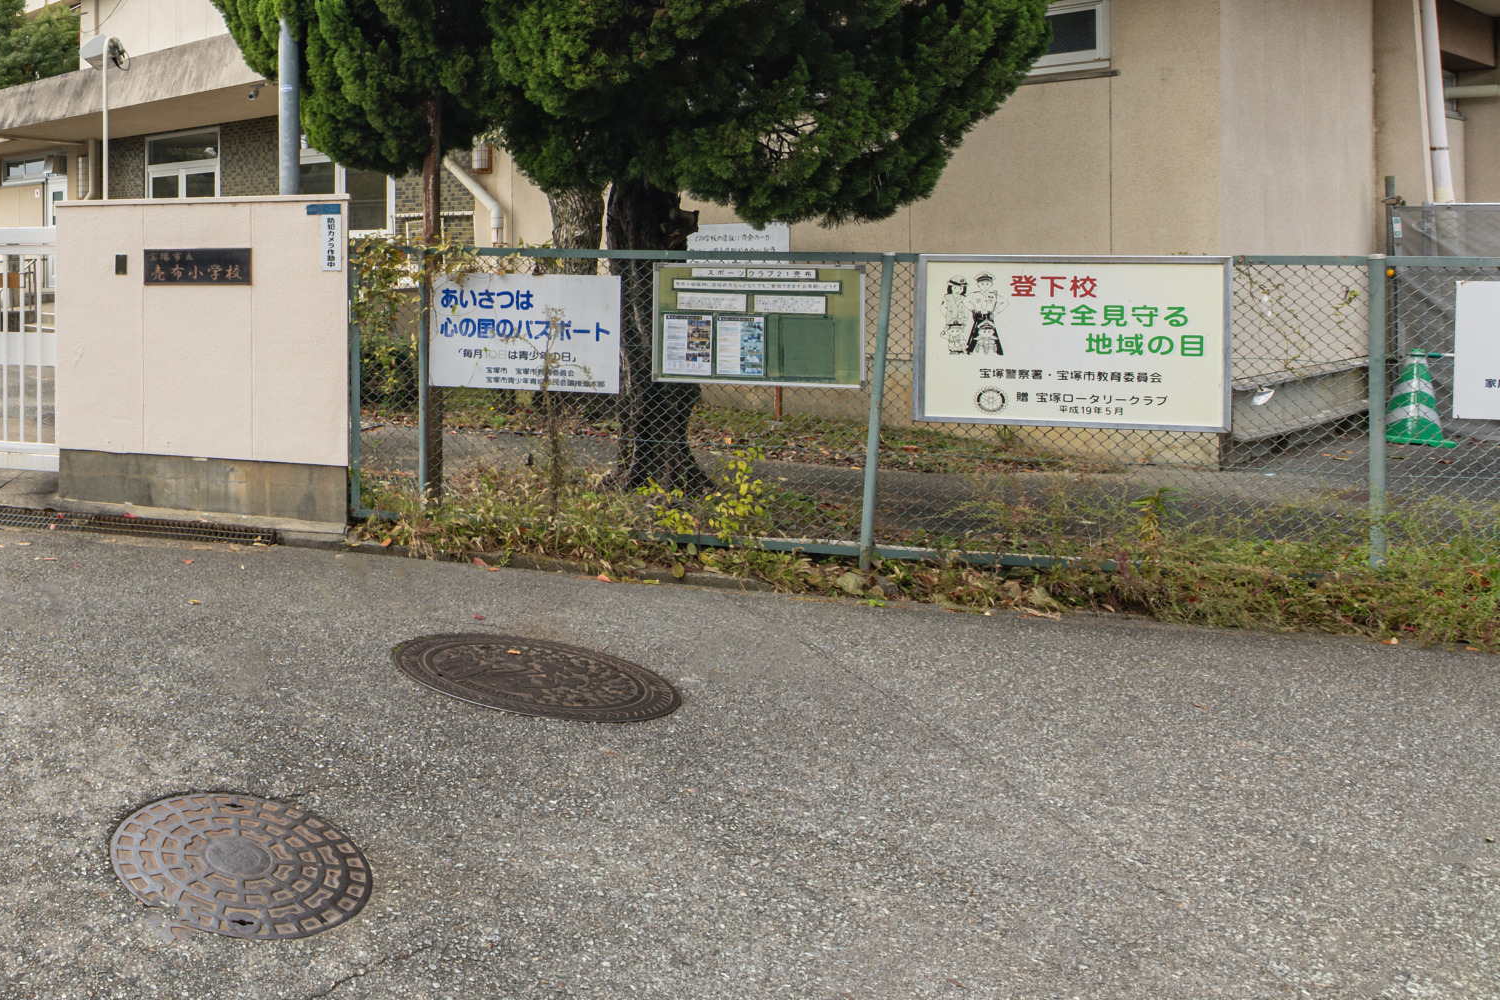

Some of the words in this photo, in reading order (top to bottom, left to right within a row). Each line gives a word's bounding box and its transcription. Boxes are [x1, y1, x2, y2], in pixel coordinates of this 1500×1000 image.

[327, 217, 336, 268] 防犯カメラ作動中
[150, 264, 243, 281] 売布小学校
[1010, 275, 1097, 299] 登下校
[440, 288, 534, 311] あいさつは
[1040, 303, 1189, 328] 安全見守る
[439, 317, 611, 342] 心の国のパスポート
[1085, 333, 1205, 357] 地域の目
[1016, 391, 1029, 403] 贈
[1036, 391, 1168, 406] 宝塚ロータリークラブ
[1059, 405, 1124, 416] 平成19年5月
